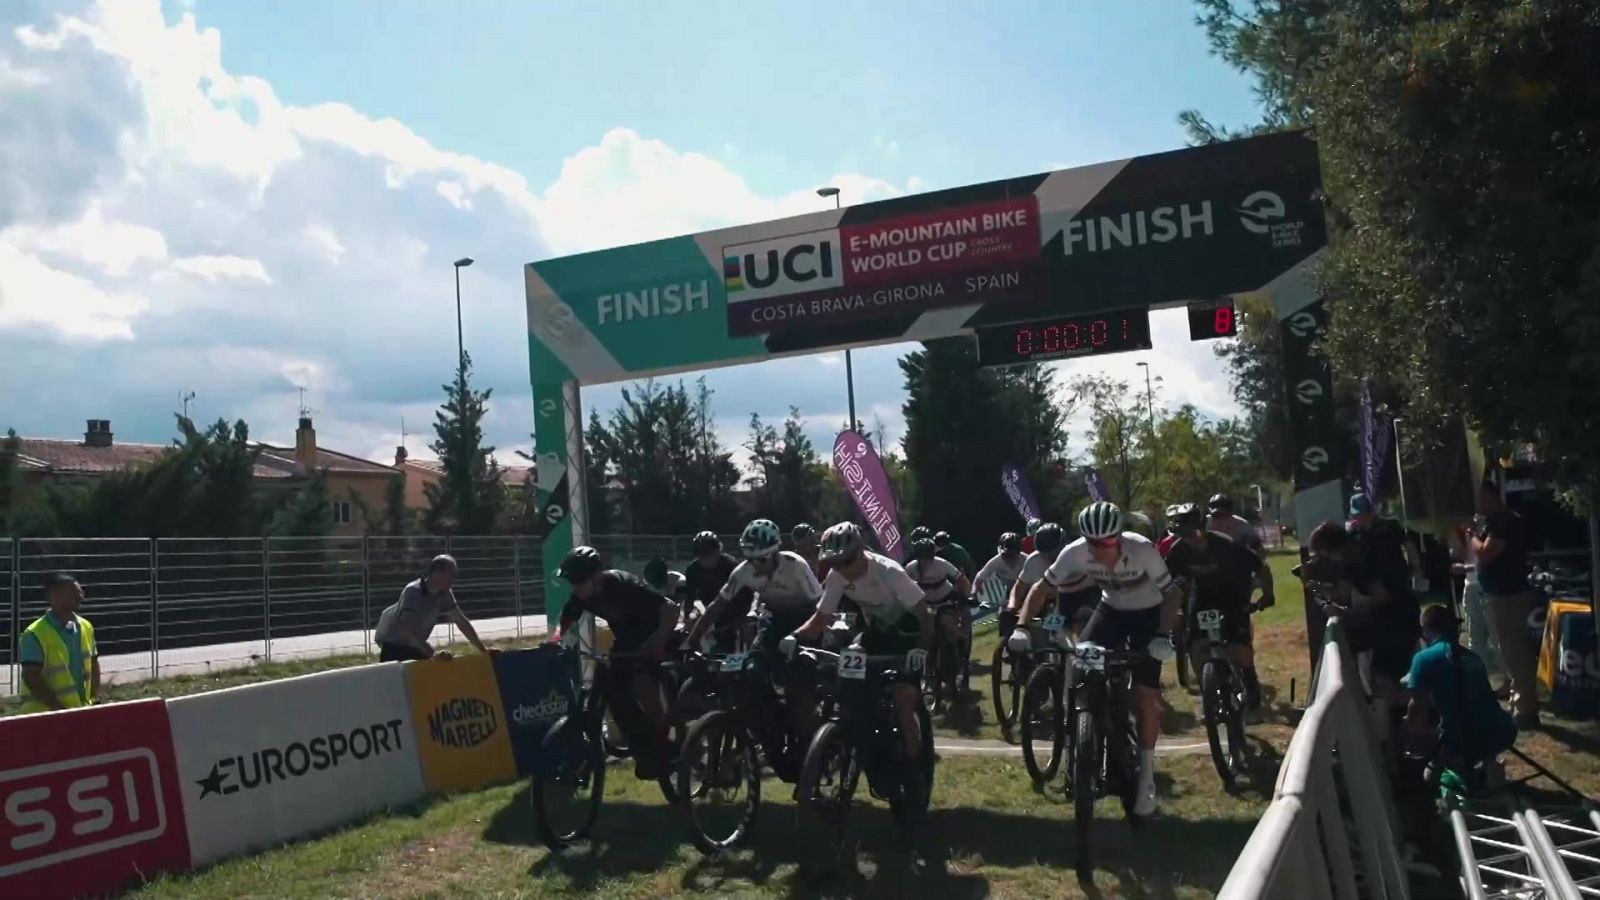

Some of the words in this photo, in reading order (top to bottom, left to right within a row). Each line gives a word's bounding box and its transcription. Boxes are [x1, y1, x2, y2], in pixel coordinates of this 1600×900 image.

[849, 216, 977, 252] E-MOUNTAIN
[983, 208, 1027, 233] BIKE
[1062, 201, 1215, 256] FINISH
[743, 240, 833, 289] UCI
[851, 247, 920, 273] WORLD
[928, 241, 967, 262] CUP
[597, 279, 710, 325] FINISH
[751, 304, 806, 323] COSTA
[965, 271, 1019, 293] SPAIN
[1215, 307, 1232, 334] 8
[1200, 612, 1217, 624] 29
[843, 655, 863, 670] 22
[1080, 647, 1101, 661] 23
[512, 699, 569, 723] checkstar
[219, 719, 403, 796] EUROSPORT
